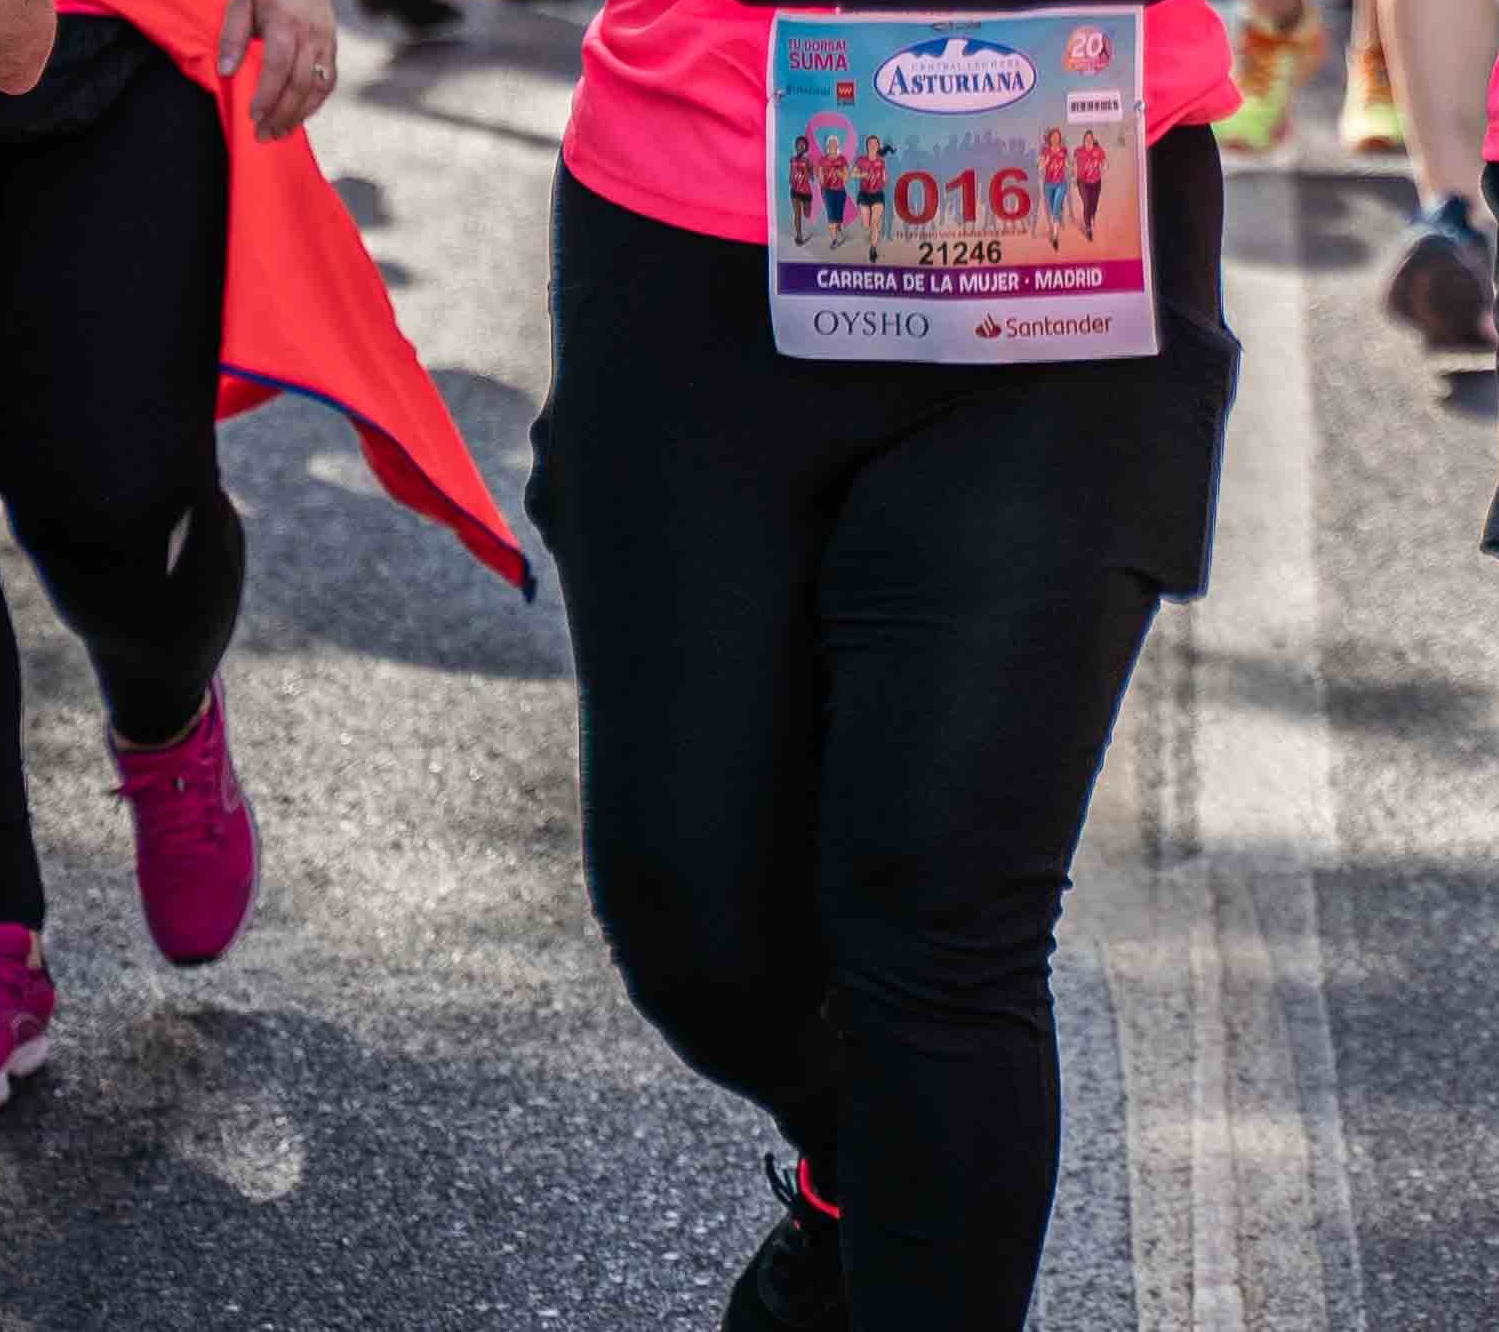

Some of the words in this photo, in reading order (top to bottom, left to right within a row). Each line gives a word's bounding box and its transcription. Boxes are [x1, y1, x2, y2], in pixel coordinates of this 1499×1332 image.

[1071, 32, 1103, 57] 20
[788, 52, 848, 72] SUMA
[888, 65, 1026, 96] ASTURIANA
[893, 167, 1032, 226] 016
[918, 240, 1002, 266] 21246
[816, 268, 897, 291] CARRERA
[903, 271, 925, 291] DE
[930, 272, 953, 293] LA
[959, 271, 1019, 292] MUJER
[1035, 266, 1102, 288] MADRID
[813, 309, 930, 338] OYSHO
[1006, 314, 1112, 337] Santander
